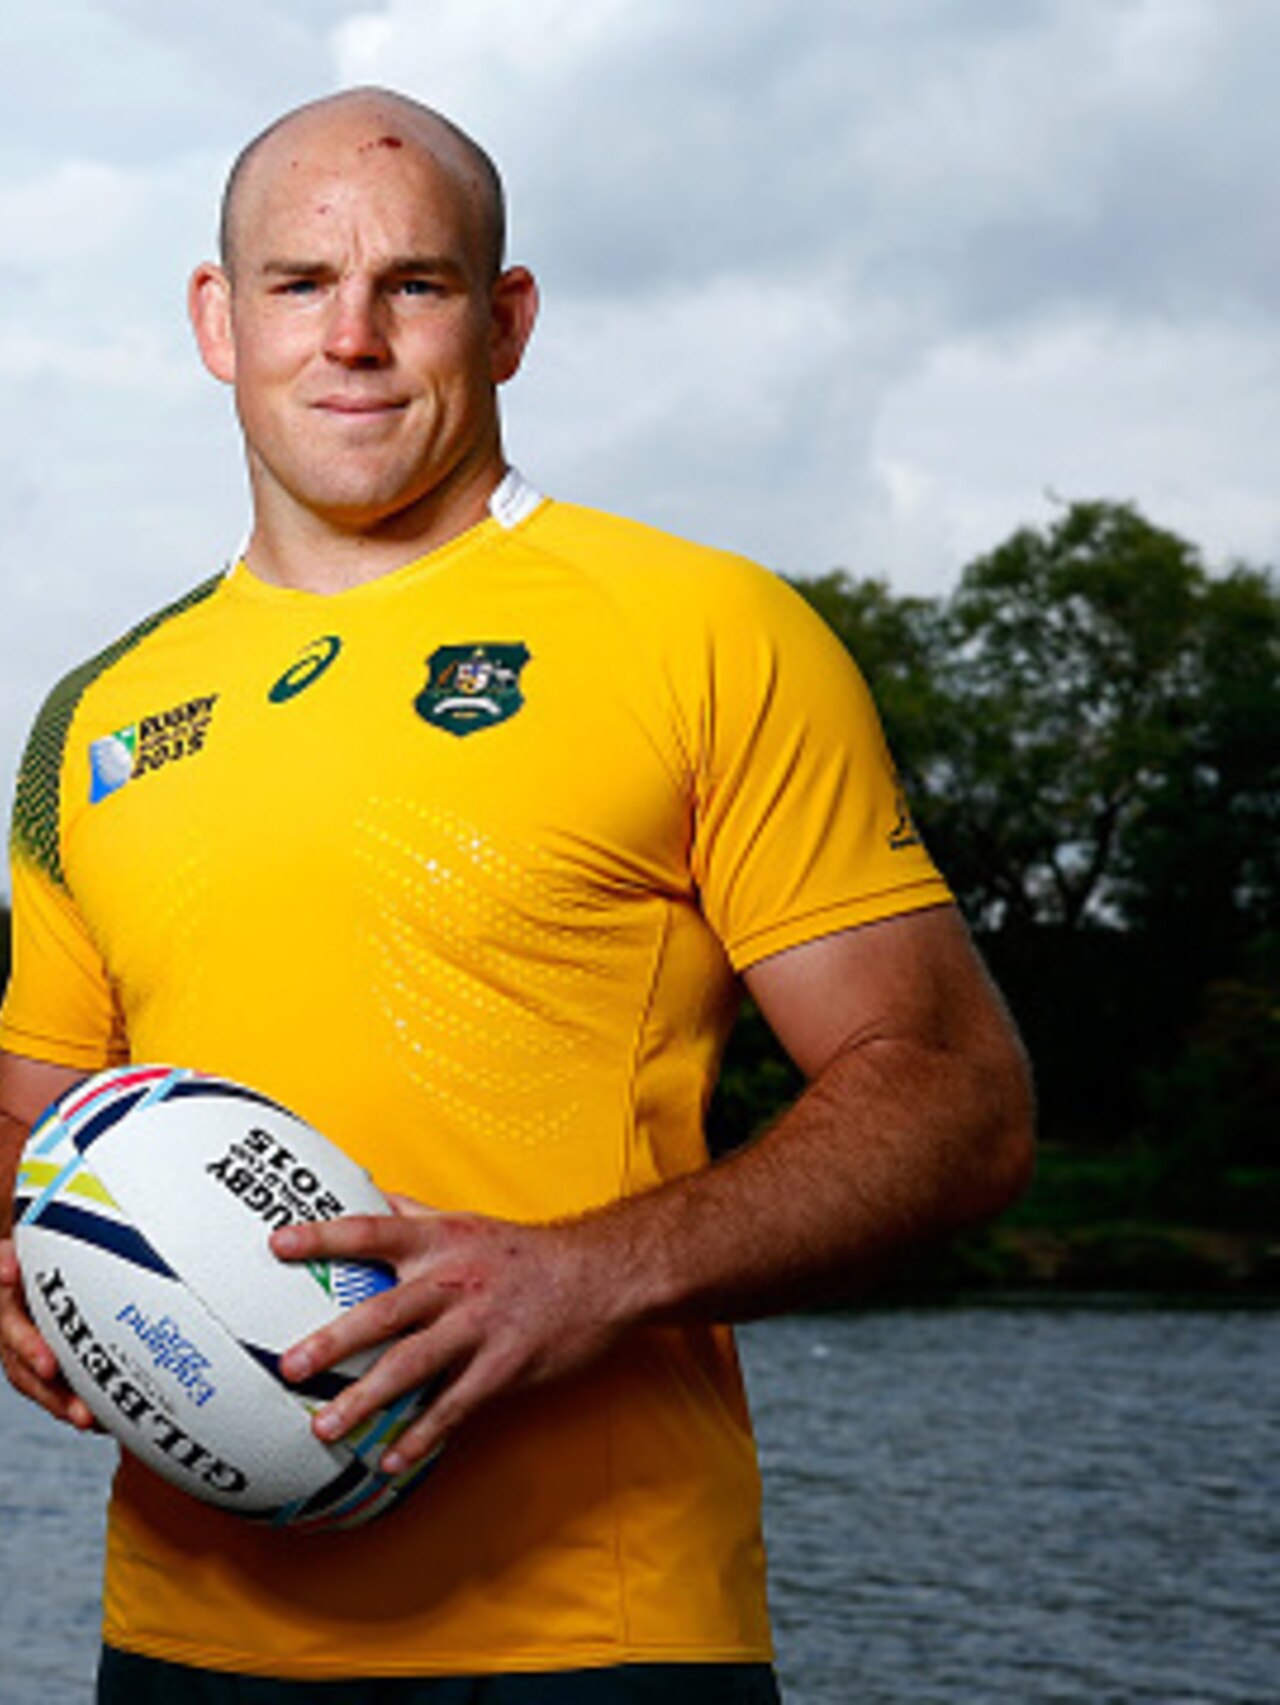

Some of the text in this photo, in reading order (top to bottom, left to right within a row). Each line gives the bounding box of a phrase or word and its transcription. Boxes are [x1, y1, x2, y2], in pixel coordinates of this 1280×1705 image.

[206, 1156, 296, 1231] UGBY
[243, 1127, 346, 1221] 2015
[35, 1267, 250, 1493] GILBERT
[115, 1303, 216, 1407] England
